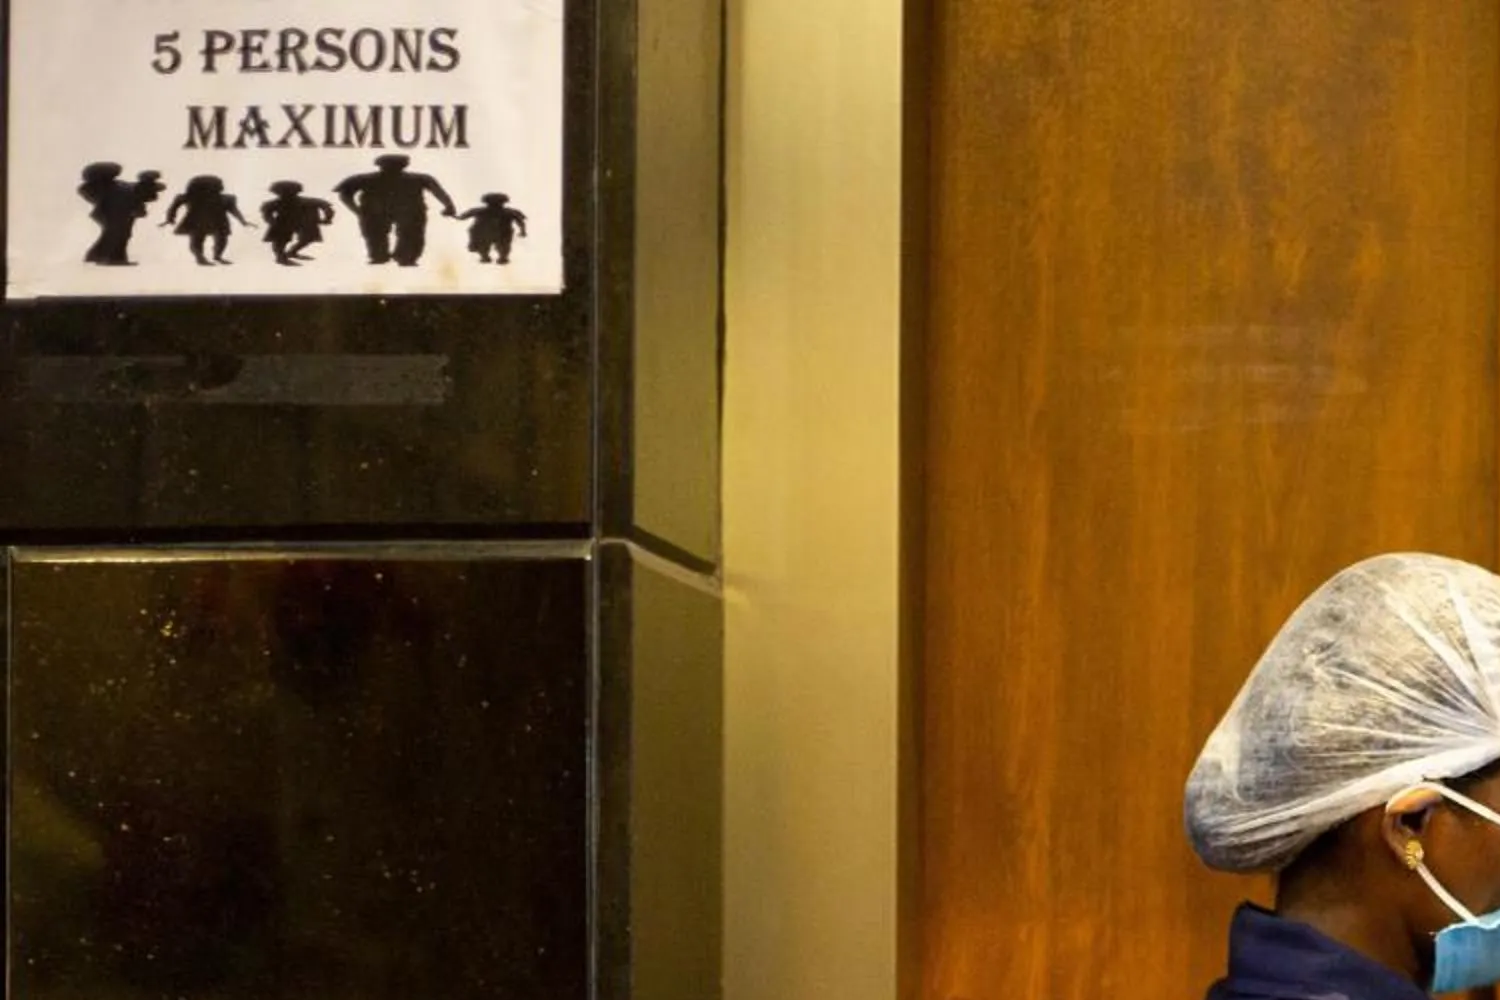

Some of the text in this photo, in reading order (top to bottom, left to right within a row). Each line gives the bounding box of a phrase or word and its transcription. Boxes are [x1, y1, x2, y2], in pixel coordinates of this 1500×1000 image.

[152, 27, 461, 75] 5 PERSONS
[183, 104, 470, 149] MAXIMUM
